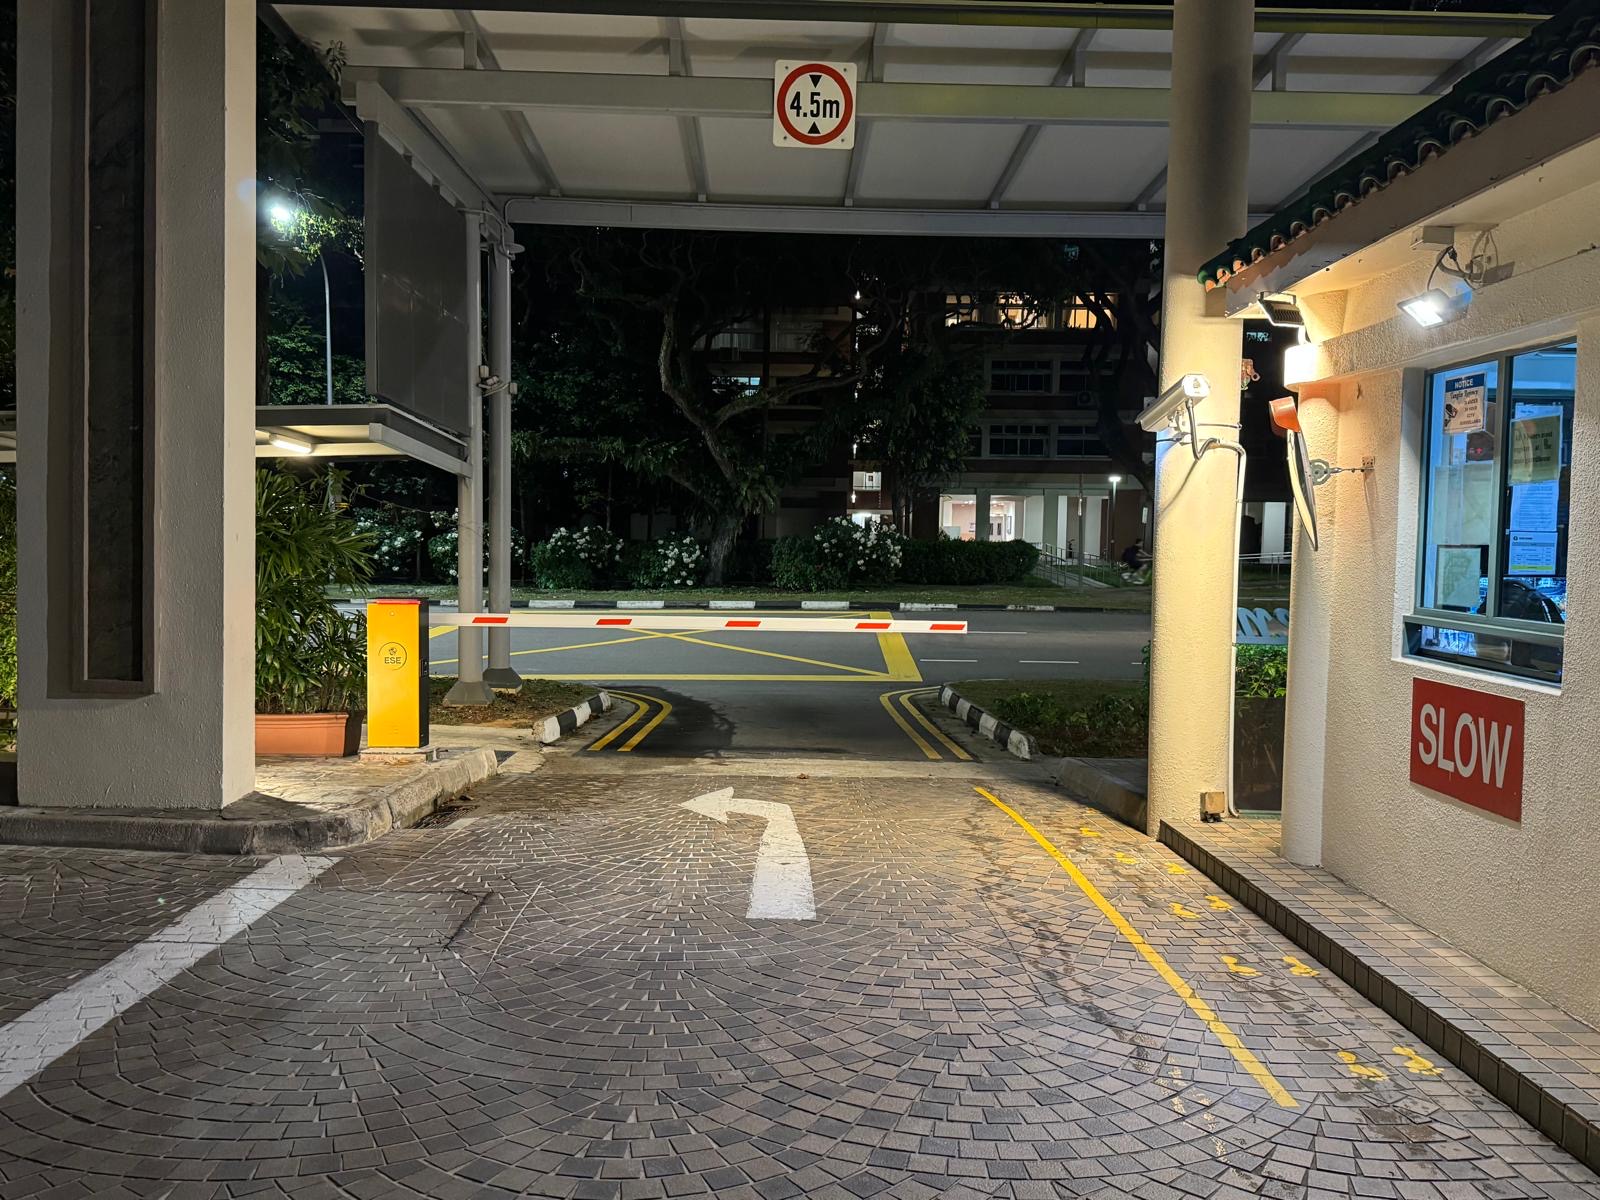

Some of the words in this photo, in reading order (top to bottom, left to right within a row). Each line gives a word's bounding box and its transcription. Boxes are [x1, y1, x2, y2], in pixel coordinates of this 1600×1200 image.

[789, 91, 840, 118] 4.5m
[1454, 378, 1474, 389] NOTICE
[384, 656, 402, 665] ESE
[1418, 703, 1513, 789] SLOW
